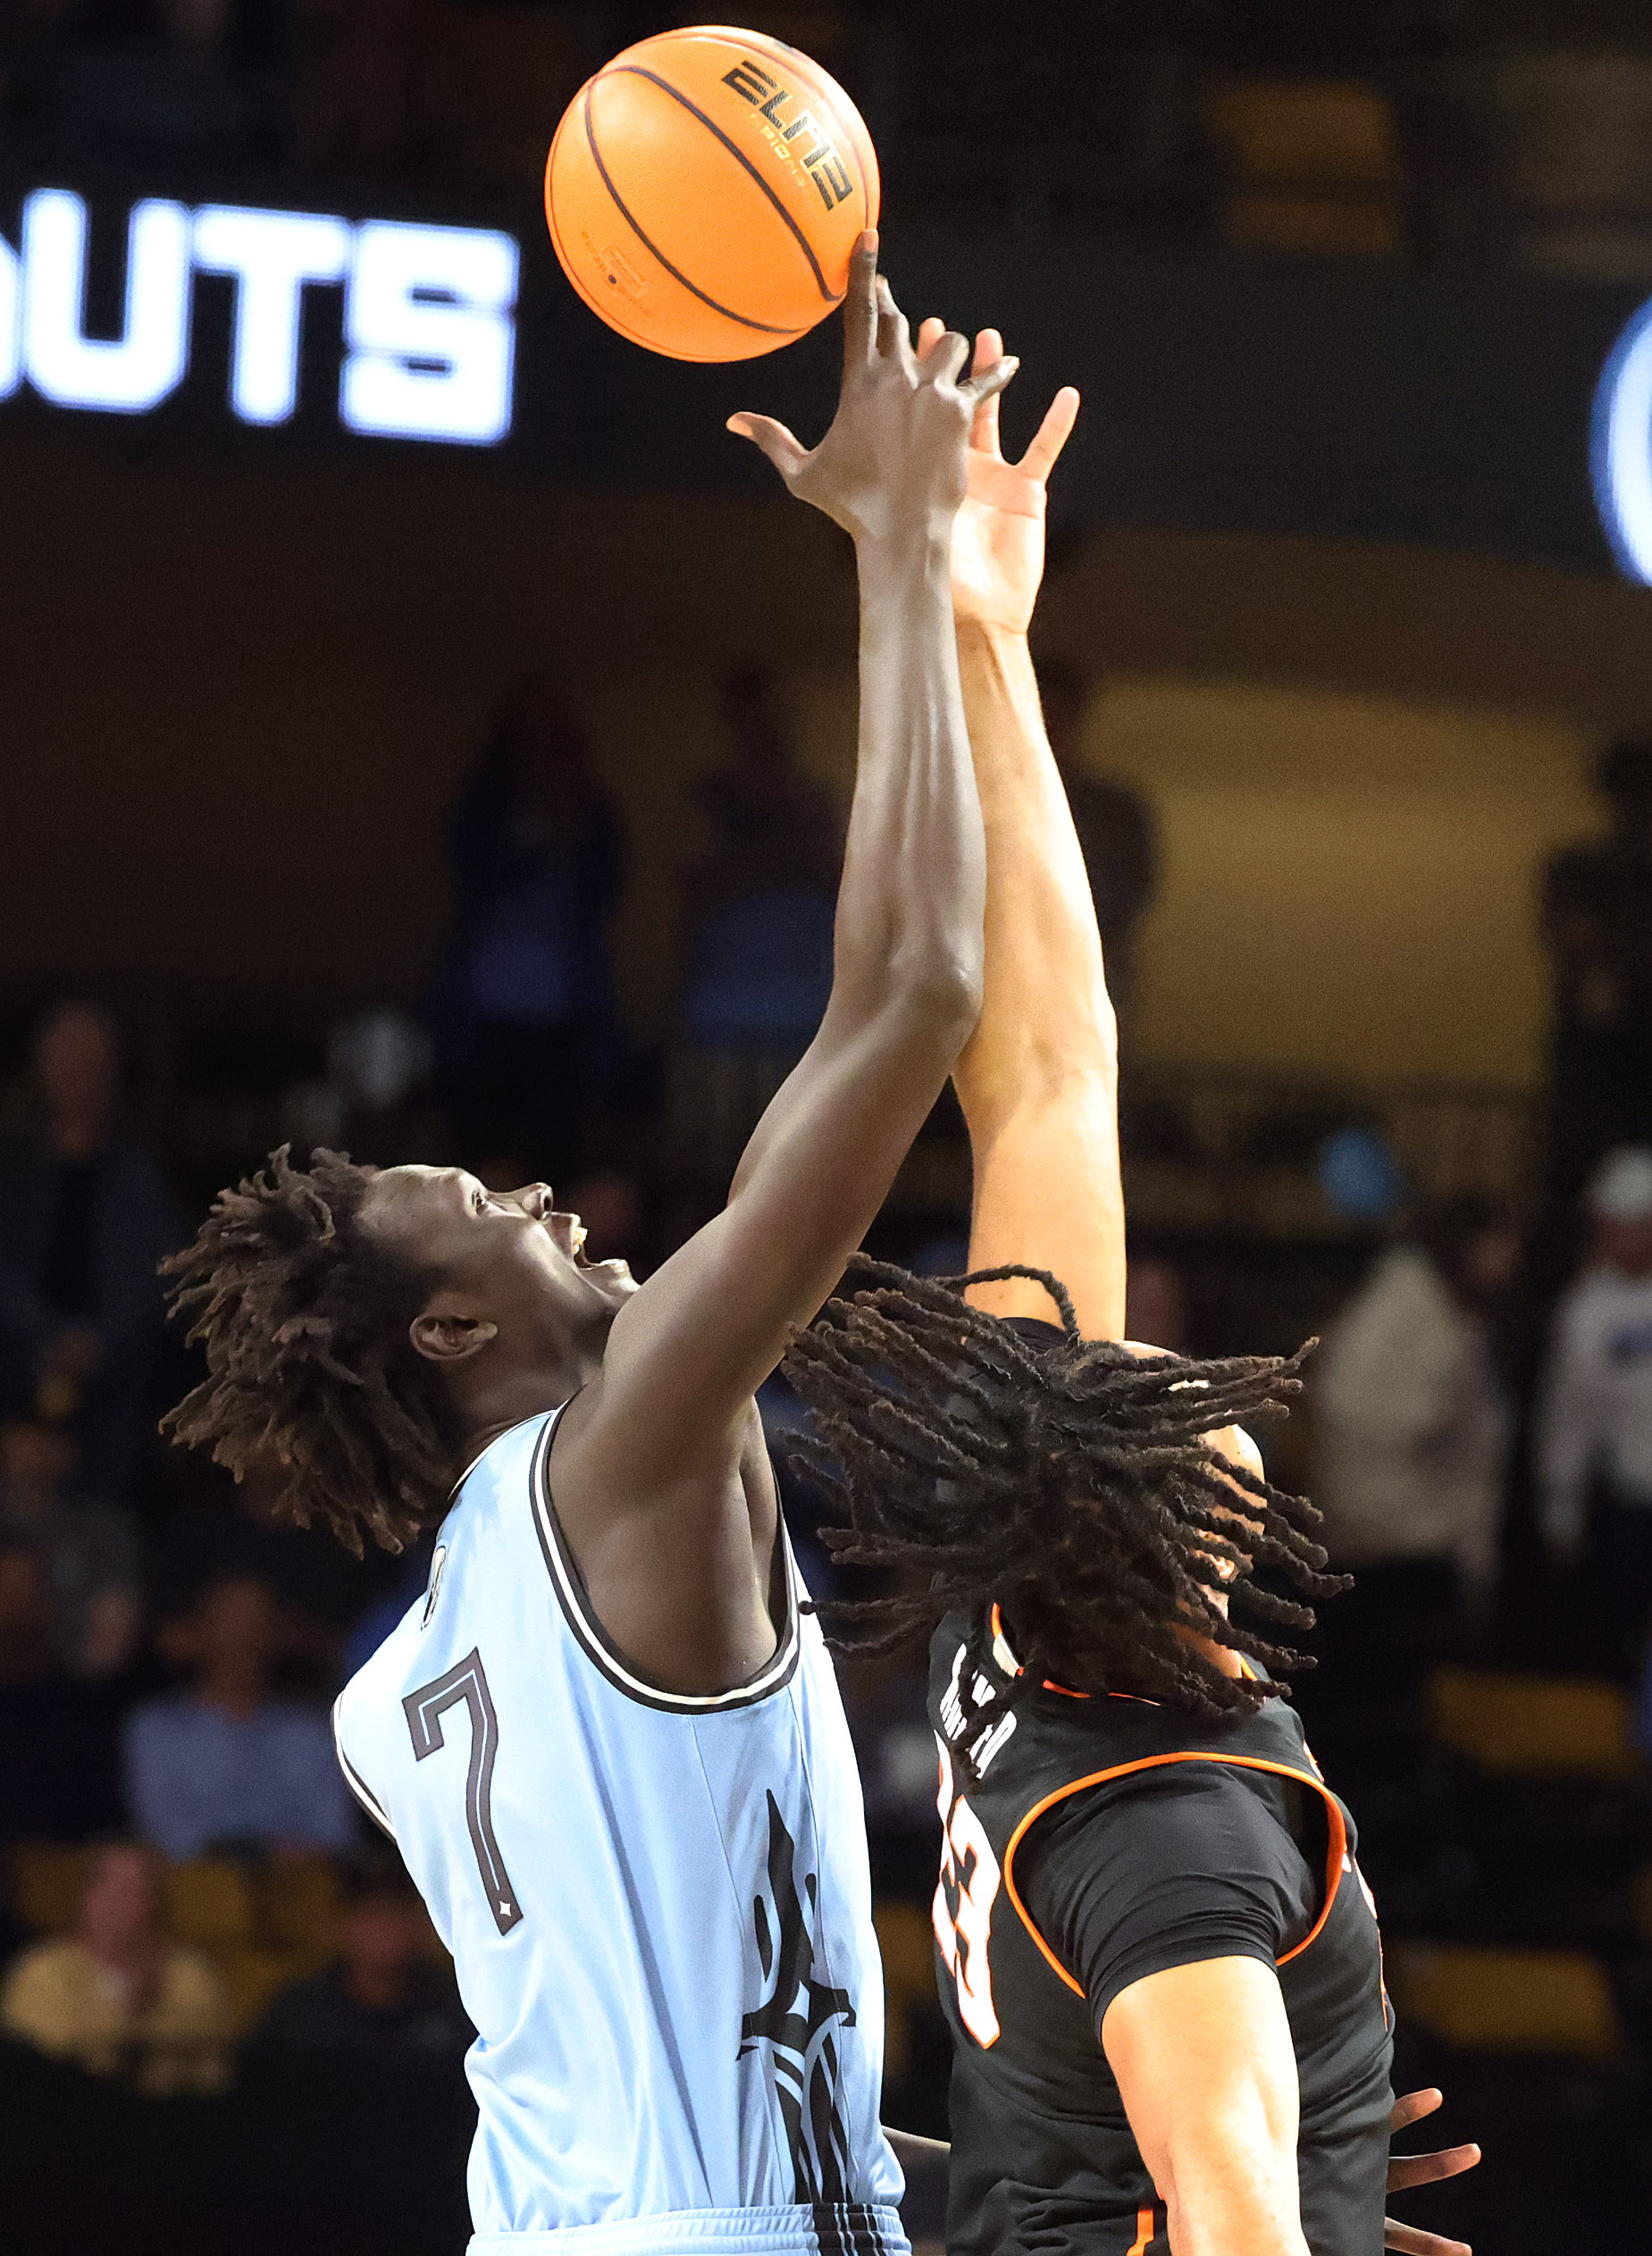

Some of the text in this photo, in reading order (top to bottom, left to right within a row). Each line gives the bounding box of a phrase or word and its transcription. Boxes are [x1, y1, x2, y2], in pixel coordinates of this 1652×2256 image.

[720, 60, 853, 213] ELITE
[0, 188, 519, 447] UTS
[404, 1647, 524, 1936] 7
